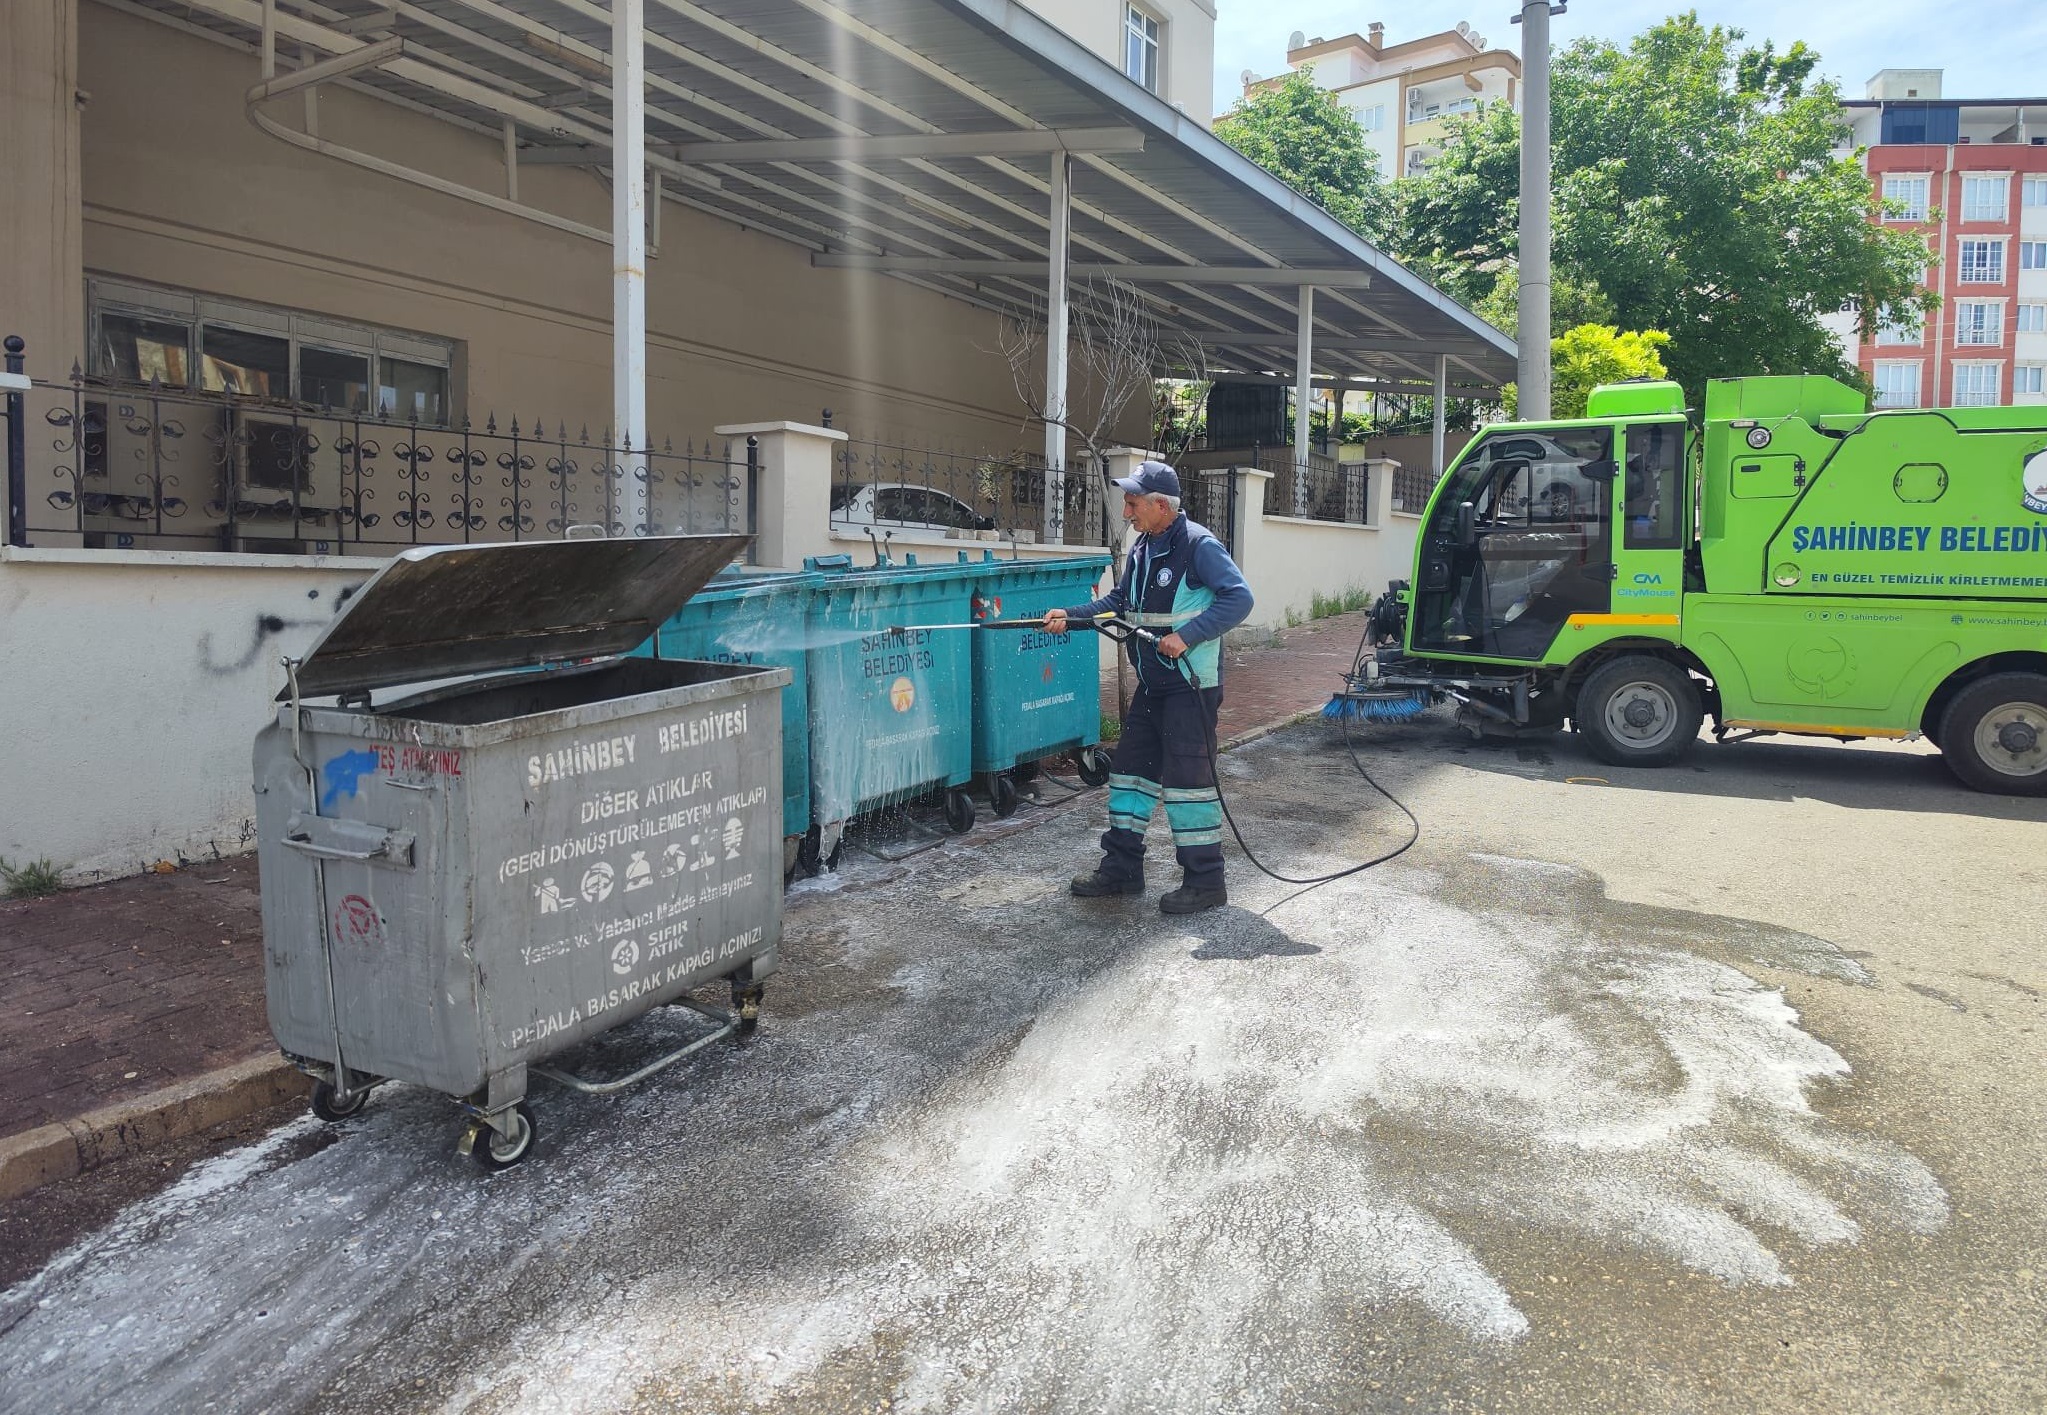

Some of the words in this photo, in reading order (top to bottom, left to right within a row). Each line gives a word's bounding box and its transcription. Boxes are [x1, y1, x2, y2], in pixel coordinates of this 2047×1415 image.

[1793, 521, 1931, 553] ŞAHİNBEY
[1617, 588, 1676, 597] CityMouse
[1811, 573, 1828, 582] EN
[1833, 572, 1875, 583] GÜZEL
[1880, 573, 1944, 584] TEMİZLİK
[658, 703, 748, 754] BELEDİYESİ
[581, 790, 639, 824] DİĞER
[645, 770, 713, 808] ATIKLAR
[499, 844, 546, 884] (GERİ
[549, 802, 712, 864] DÖNÜŞTÜRÜLEMEYEN
[648, 920, 688, 946] SIFIR
[648, 935, 684, 961] ATIK
[511, 1006, 581, 1048] PEDALA
[587, 970, 661, 1017] BASARAK
[667, 946, 714, 983] KAPAĞI
[719, 926, 762, 959] AÇINIZ!
